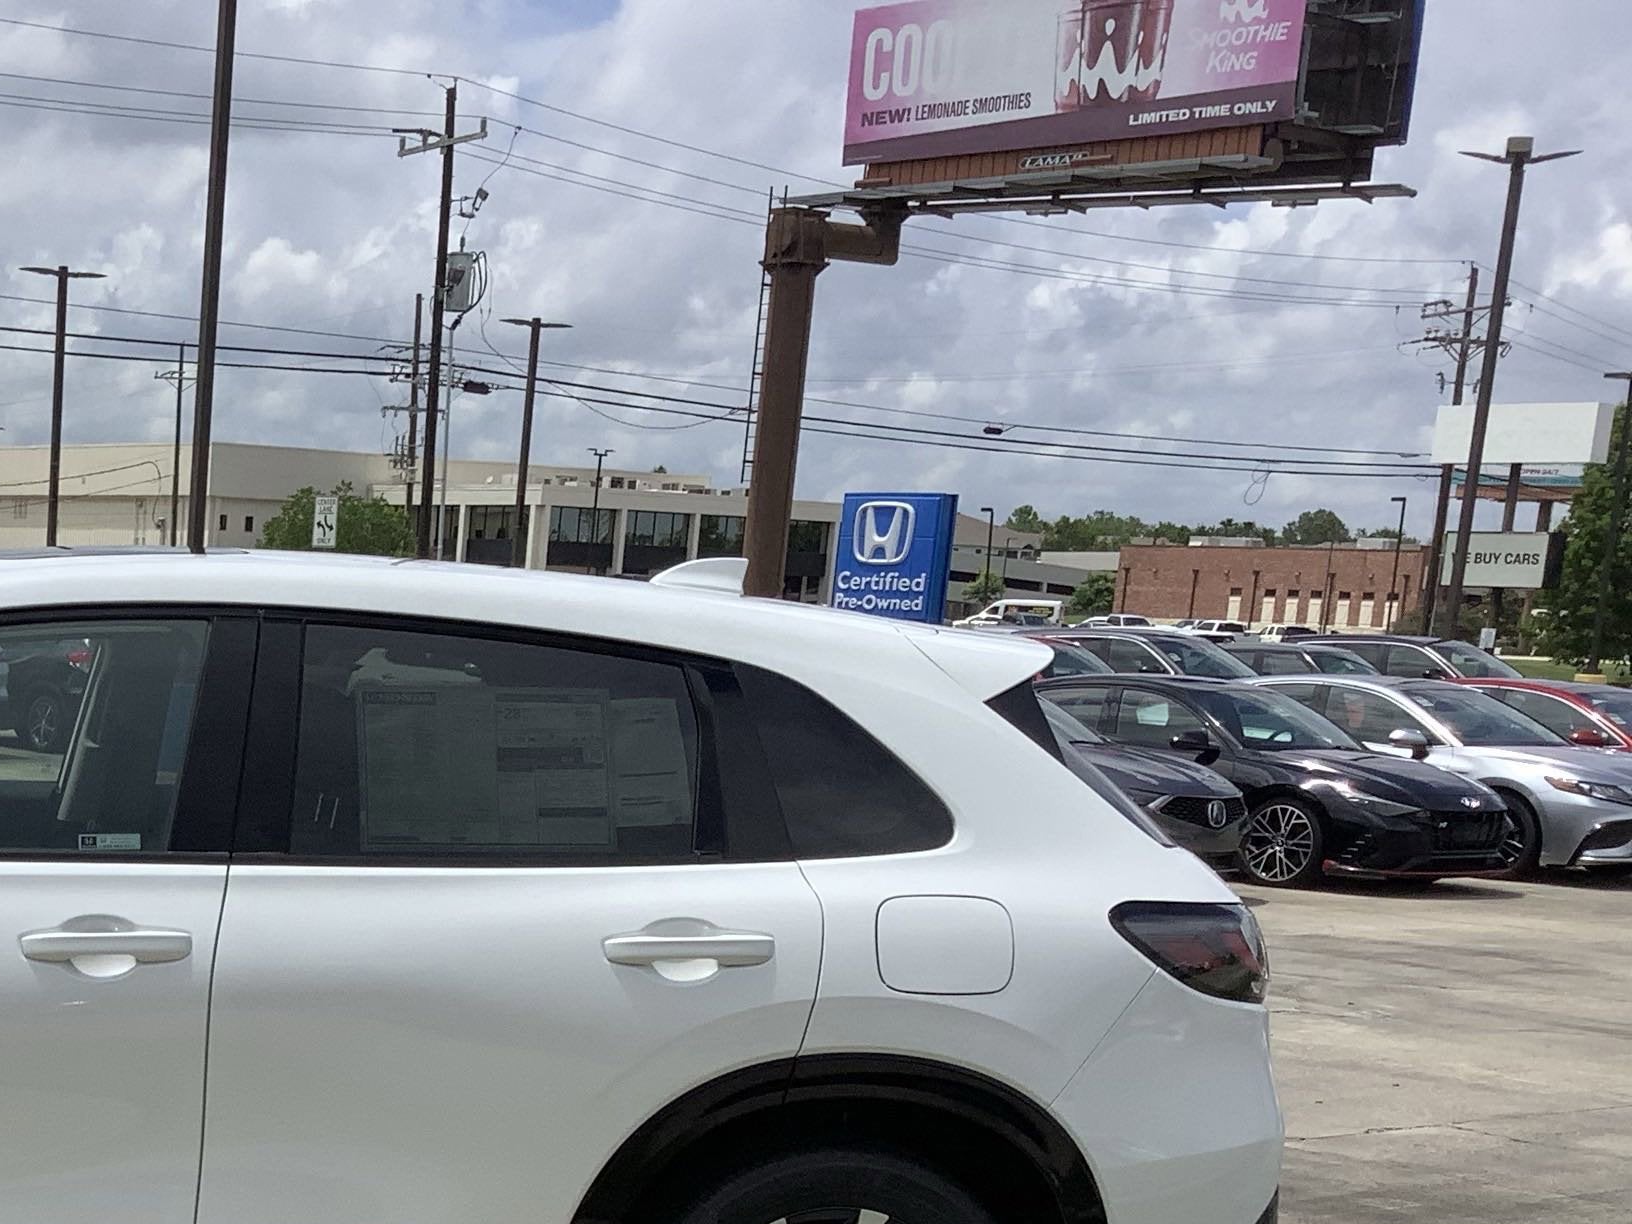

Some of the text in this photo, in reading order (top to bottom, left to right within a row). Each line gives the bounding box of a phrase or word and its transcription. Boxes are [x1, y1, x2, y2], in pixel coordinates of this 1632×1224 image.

[1189, 21, 1293, 49] SMOOTHIE
[861, 92, 1032, 127] NEW! LEMONADE SMOOTHIES
[1128, 99, 1277, 126] LIMITED TIME ONLY
[1474, 552, 1502, 565] BUY
[1504, 552, 1540, 566] CARS
[837, 570, 927, 592] Certified
[833, 592, 924, 611] Pre-Owned
